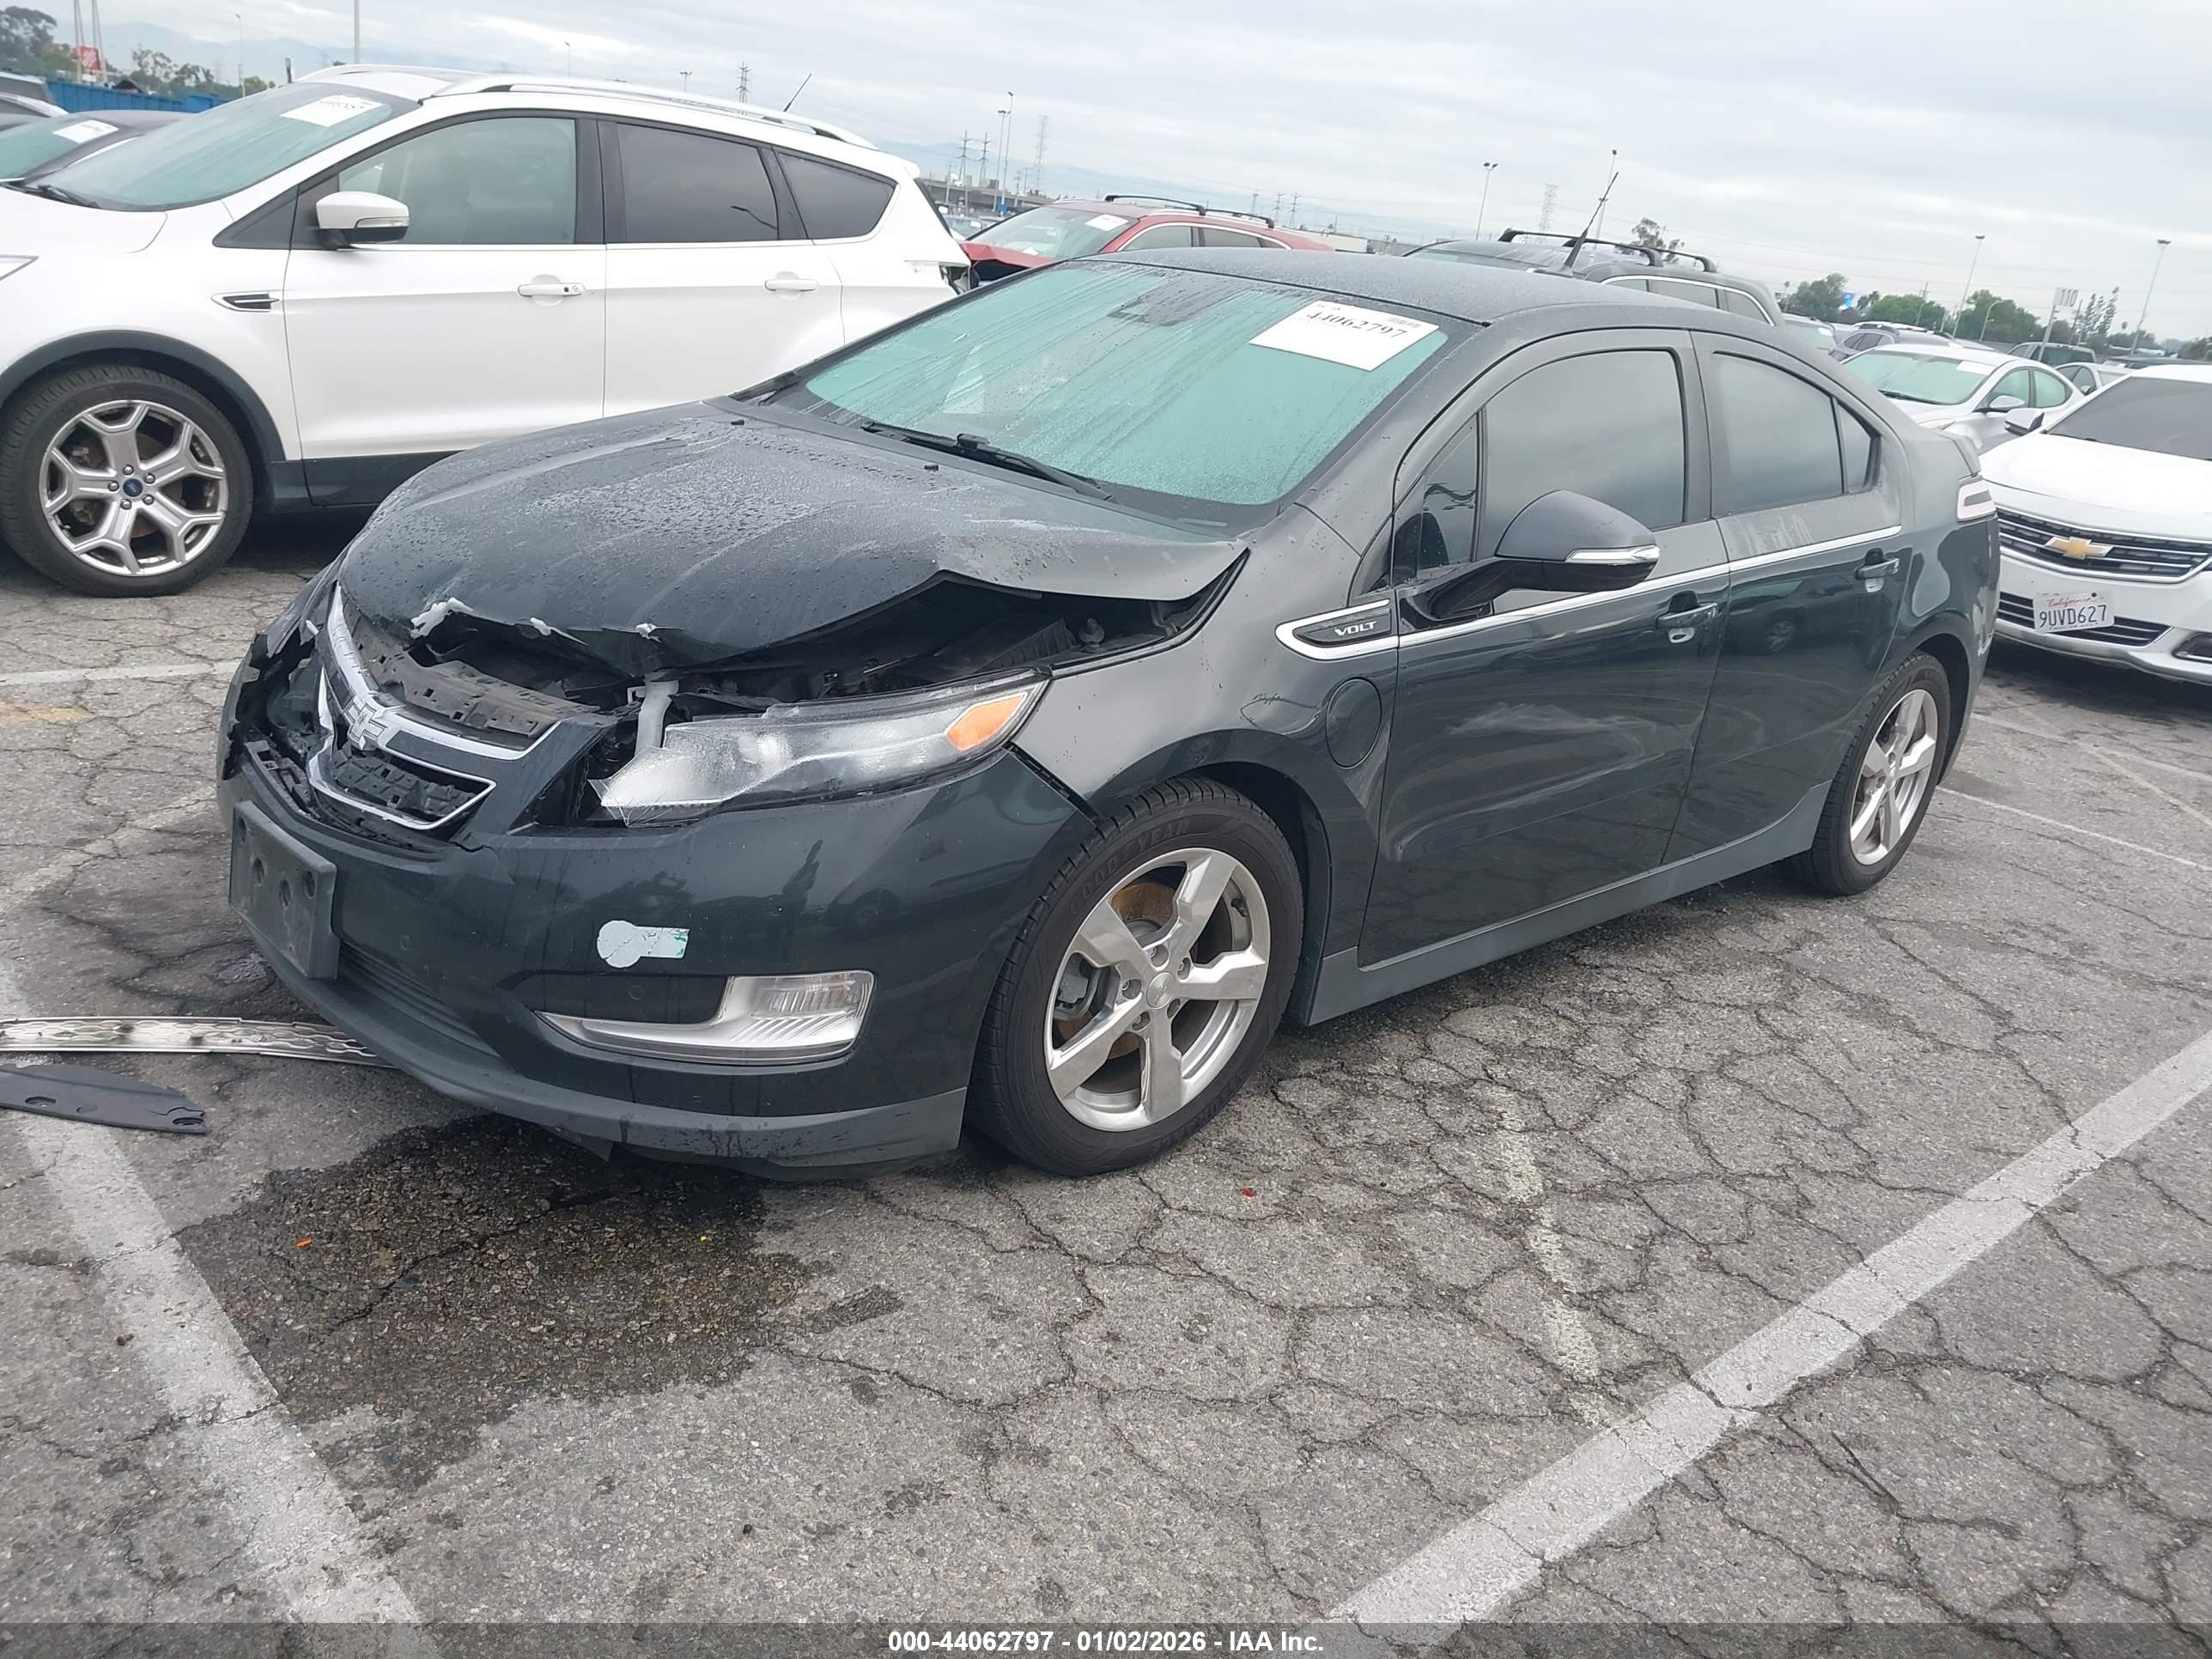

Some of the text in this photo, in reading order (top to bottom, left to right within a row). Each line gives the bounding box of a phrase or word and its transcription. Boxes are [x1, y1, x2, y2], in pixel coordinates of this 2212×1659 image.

[2047, 596, 2093, 609] California
[2039, 604, 2107, 629] 9UVD627
[1334, 620, 1378, 637] VOLT
